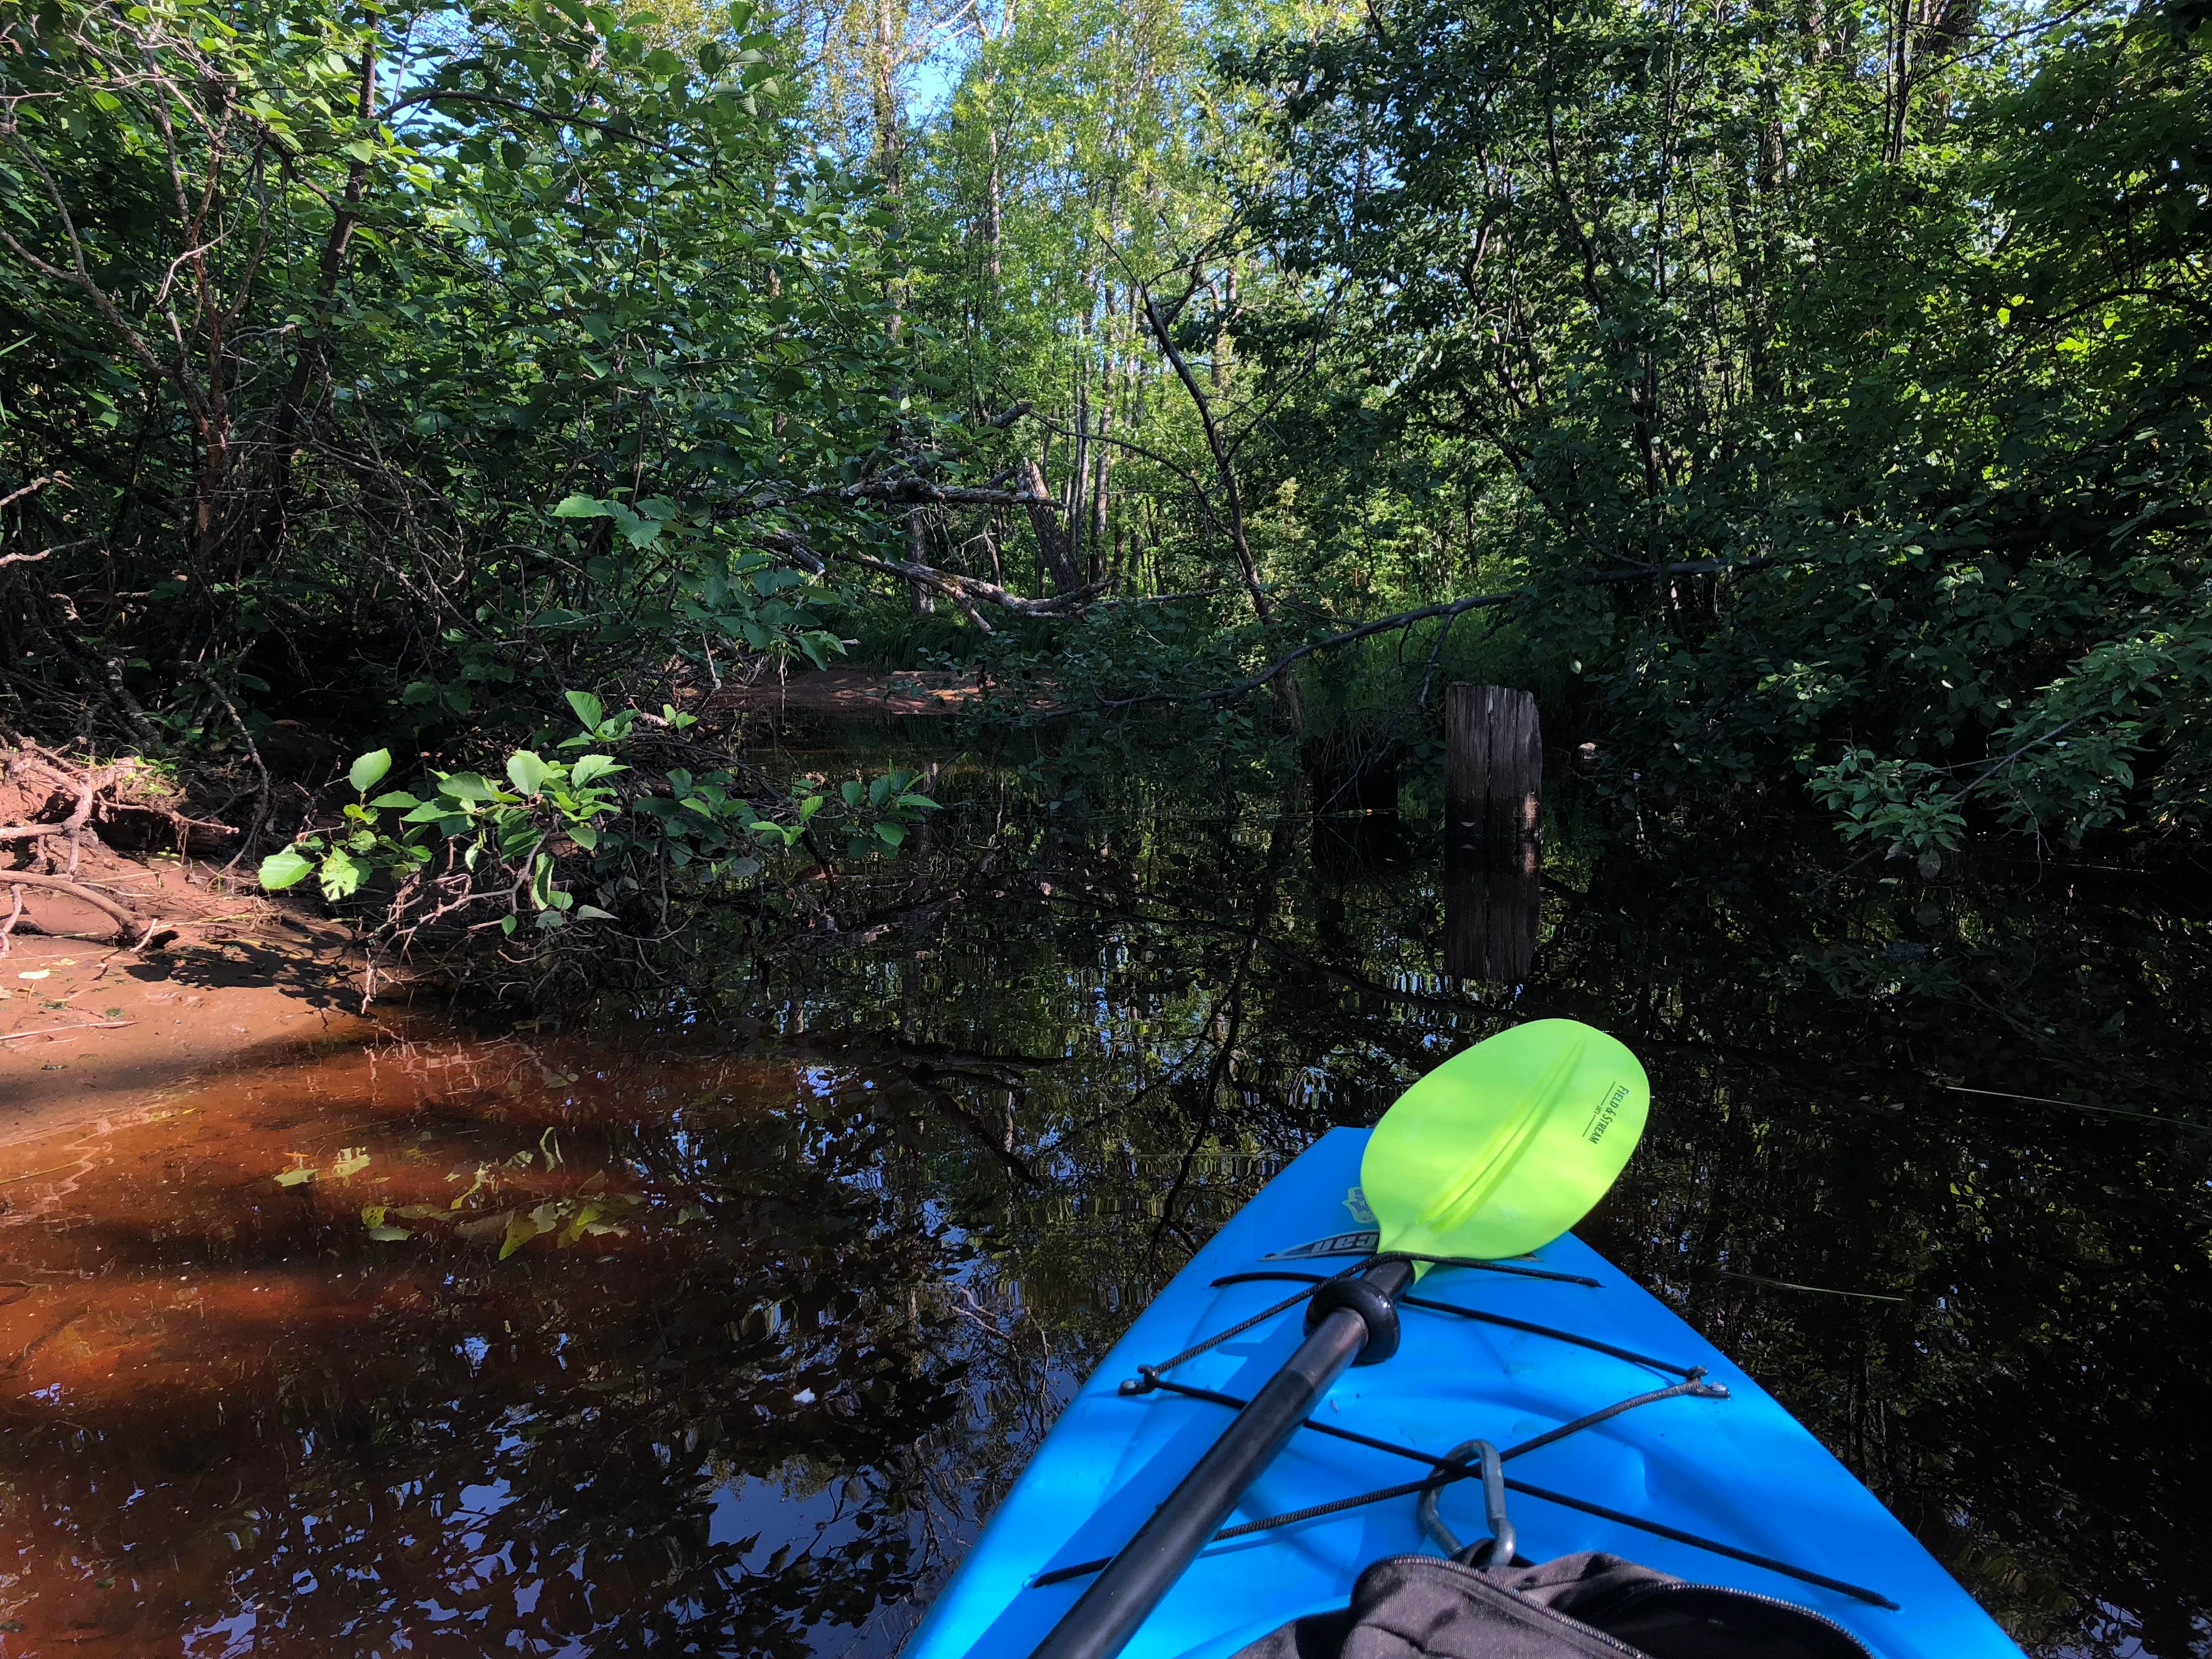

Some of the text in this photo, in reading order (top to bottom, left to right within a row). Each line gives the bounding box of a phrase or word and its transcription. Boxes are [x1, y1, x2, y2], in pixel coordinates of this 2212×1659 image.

[1589, 1085, 1629, 1144] FIELD & STREAM
